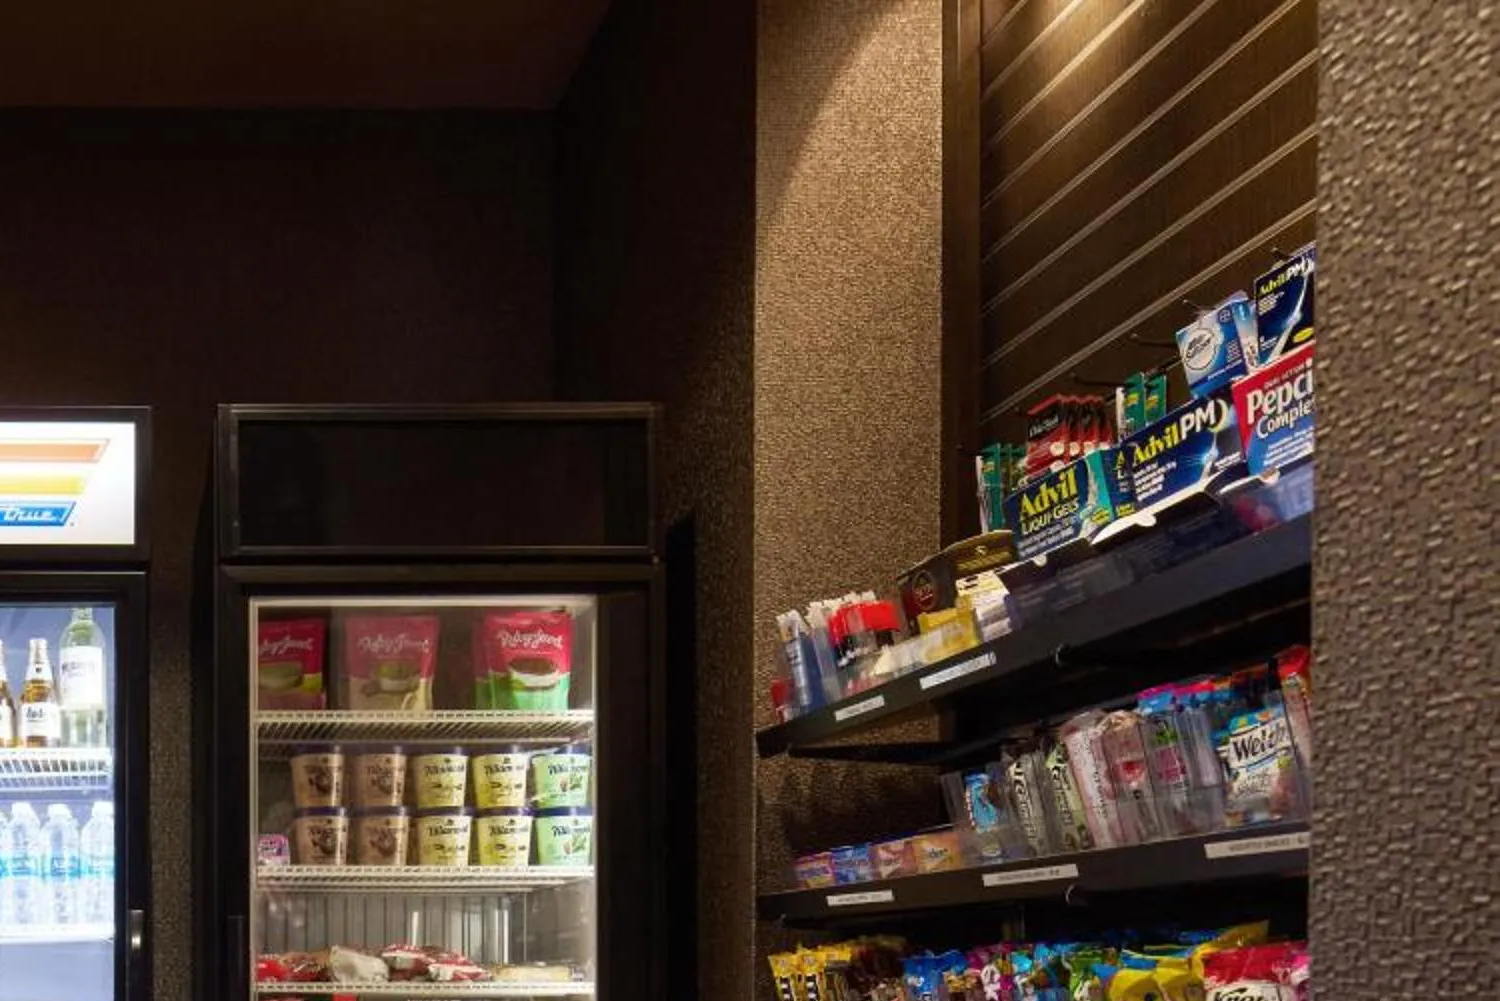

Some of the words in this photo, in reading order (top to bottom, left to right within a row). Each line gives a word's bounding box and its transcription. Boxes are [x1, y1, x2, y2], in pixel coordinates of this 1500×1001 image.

[1246, 358, 1313, 425] Pepci
[1257, 395, 1314, 438] Comple
[1133, 421, 1179, 464] Advil
[1180, 400, 1216, 441] PM
[1020, 466, 1079, 518] Advil
